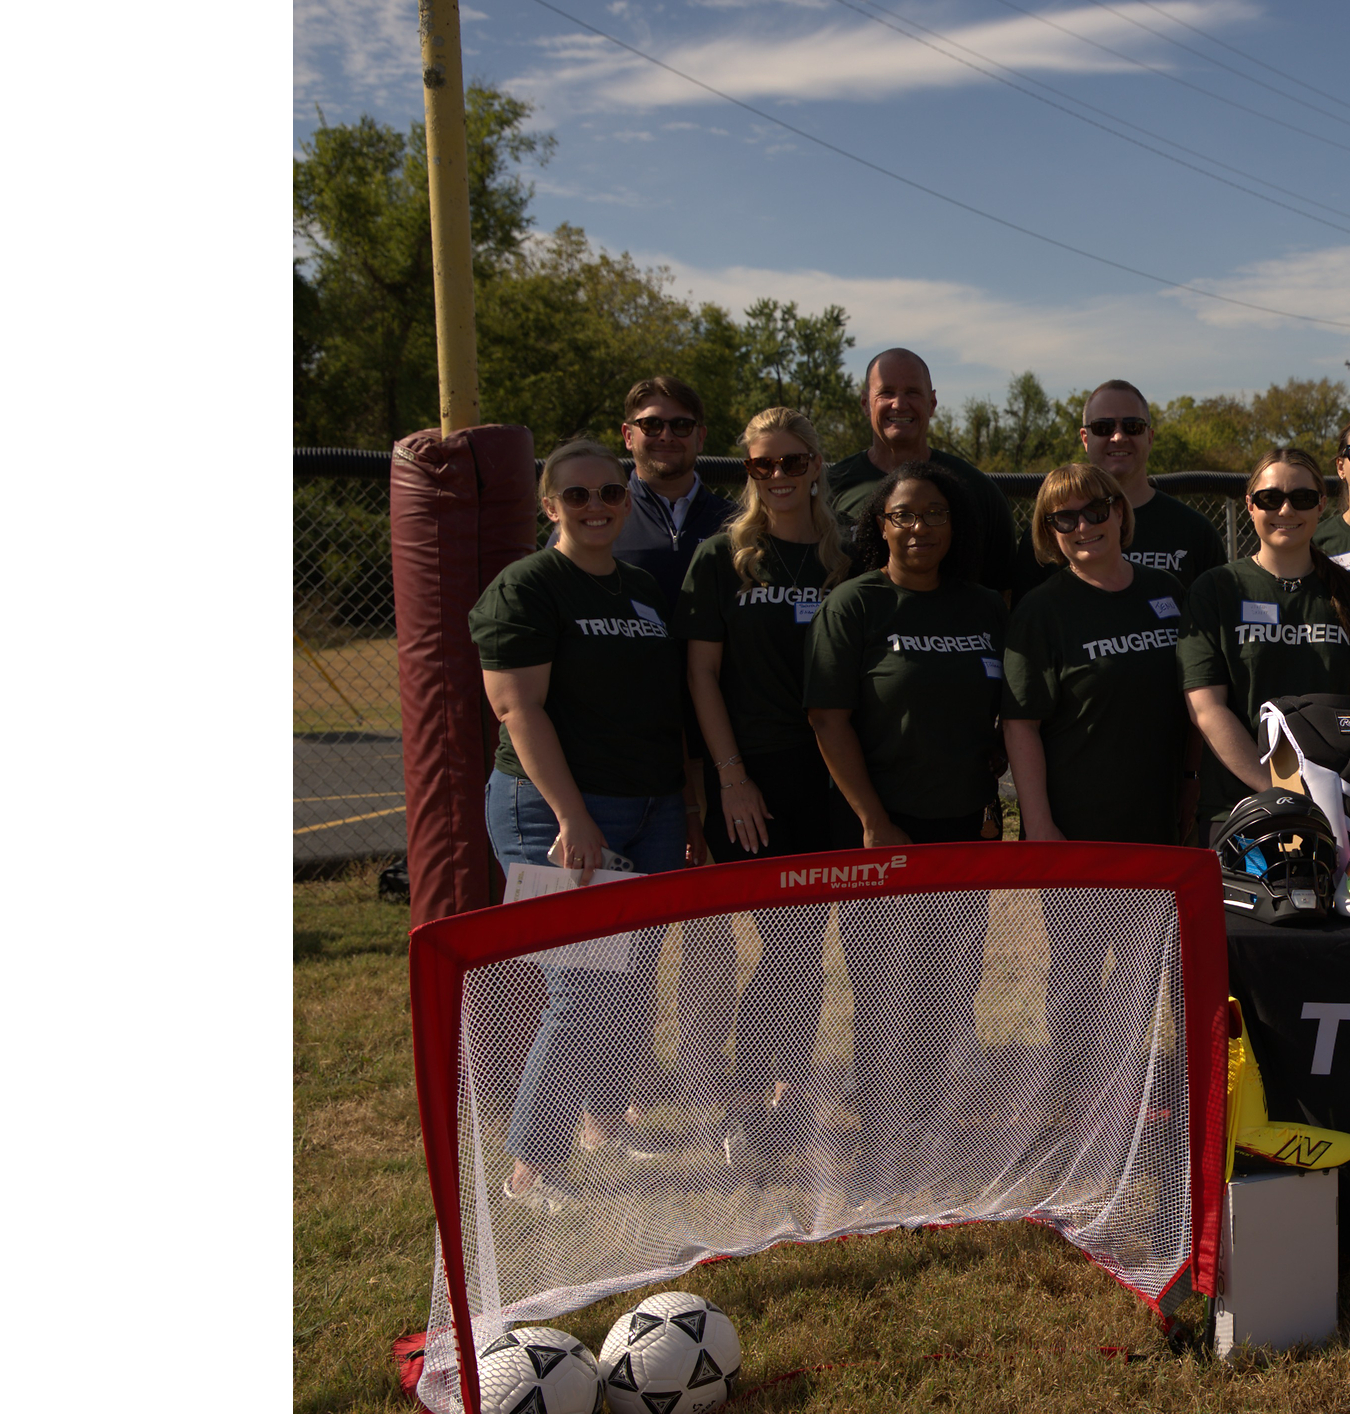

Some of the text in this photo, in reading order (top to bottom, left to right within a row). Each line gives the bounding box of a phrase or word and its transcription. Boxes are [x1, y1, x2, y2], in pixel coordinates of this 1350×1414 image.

[887, 632, 996, 653] TRUGREEN
[1082, 628, 1179, 661] TRUGREE
[830, 879, 885, 889] Weighted
